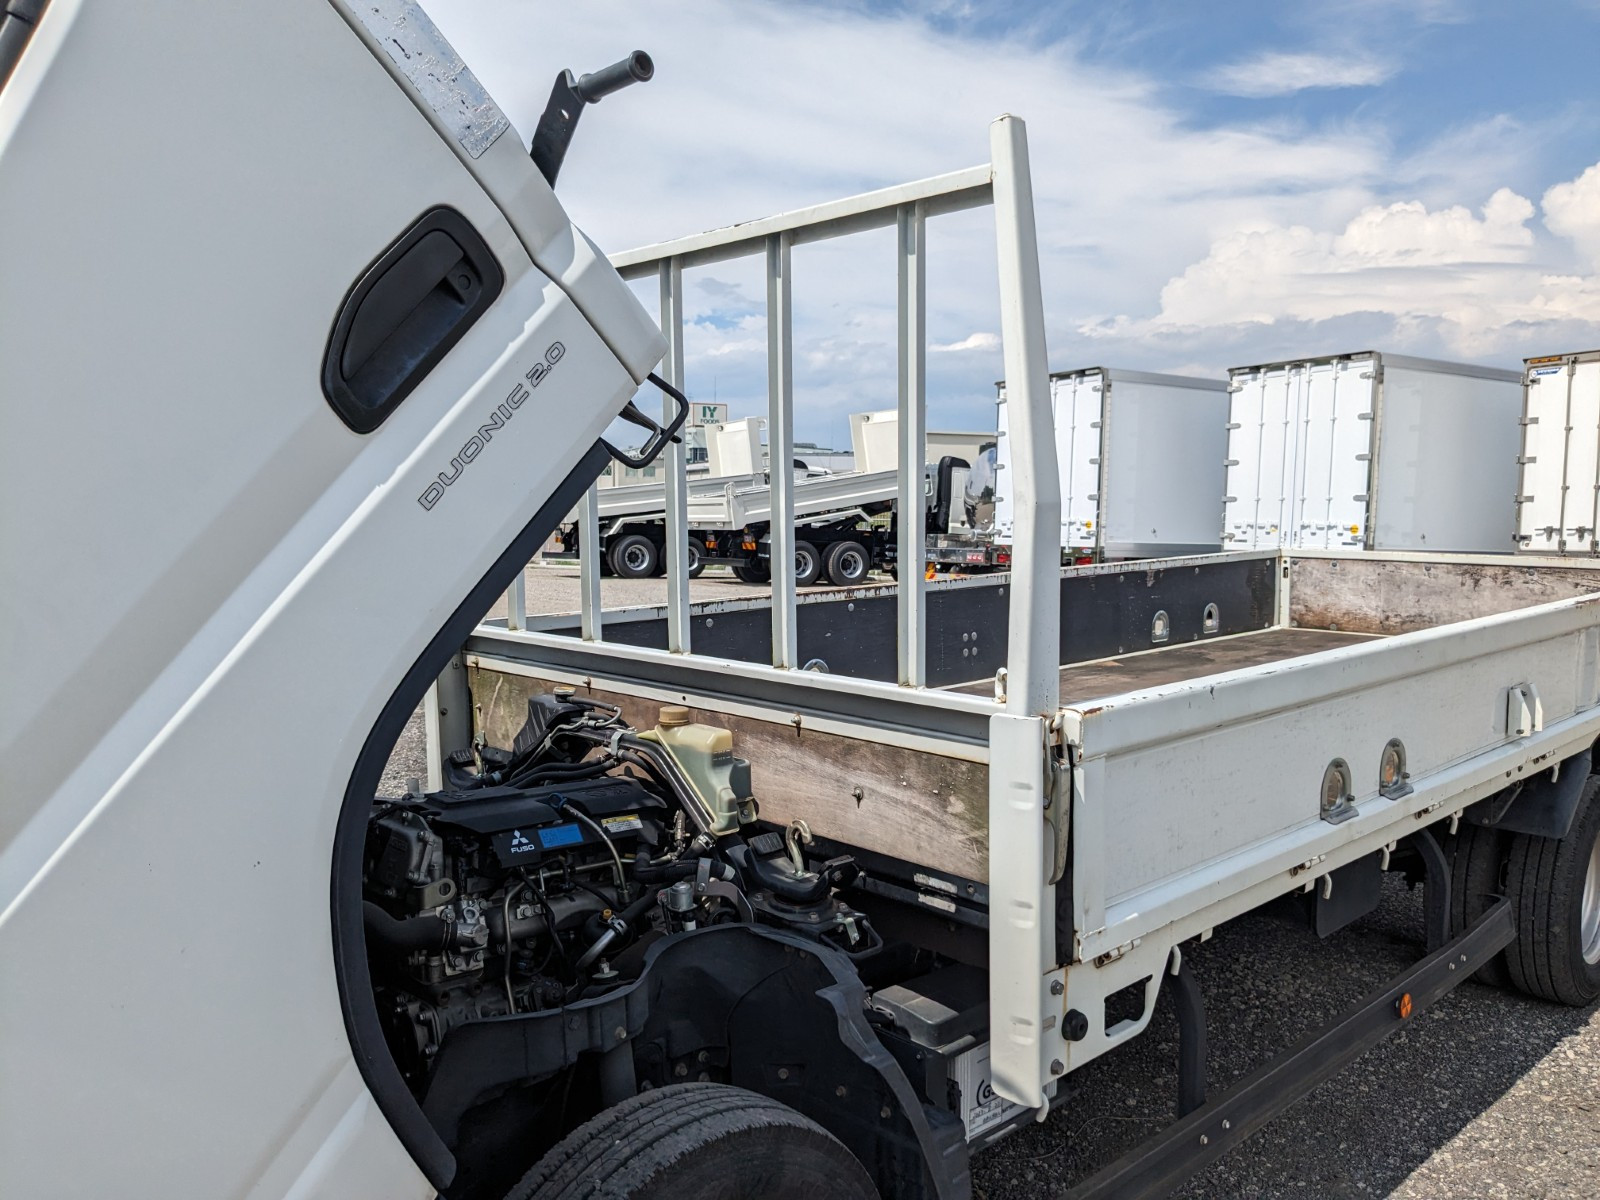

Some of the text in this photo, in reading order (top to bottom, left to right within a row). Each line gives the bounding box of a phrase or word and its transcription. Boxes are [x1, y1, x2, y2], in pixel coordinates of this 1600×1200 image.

[702, 406, 718, 418] IY
[418, 341, 566, 511] DUONIC 2.0
[510, 844, 535, 853] FUSO
